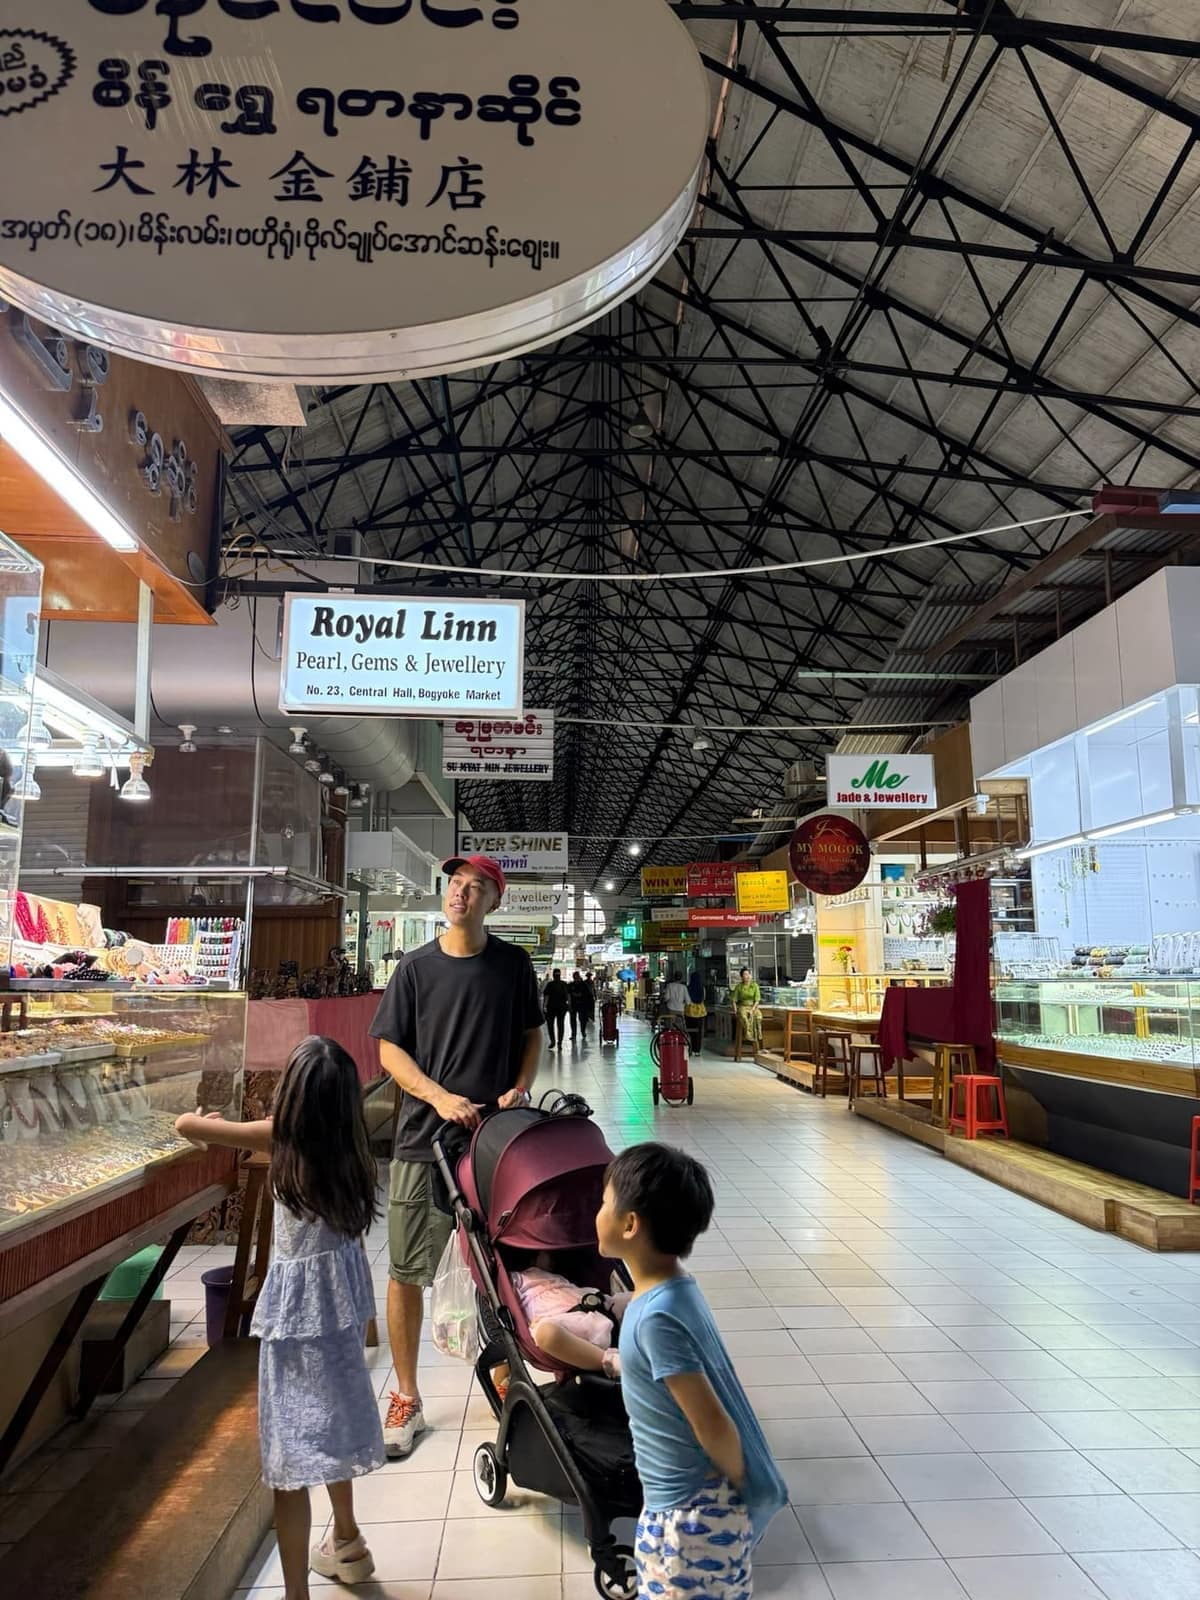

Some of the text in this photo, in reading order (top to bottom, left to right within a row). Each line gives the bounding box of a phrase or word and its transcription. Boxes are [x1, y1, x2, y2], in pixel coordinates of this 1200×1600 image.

[92, 58, 582, 147] စိန် ရွှေ ရတနာဆိုင်
[310, 606, 498, 644] Royal Linn
[295, 651, 506, 681] Pearl, Gems & Jewellery
[306, 684, 501, 702] No. 23, Central Hall, Bogyoke Market
[446, 762, 550, 773] SU MYAT MIN JEWELLERY
[851, 759, 910, 789] Me
[837, 792, 928, 804] Jade & Jewellery
[462, 834, 563, 852] EVER SHINE
[796, 842, 864, 855] MY MOGOK
[645, 878, 669, 887] WIN
[727, 914, 756, 922] Registered
